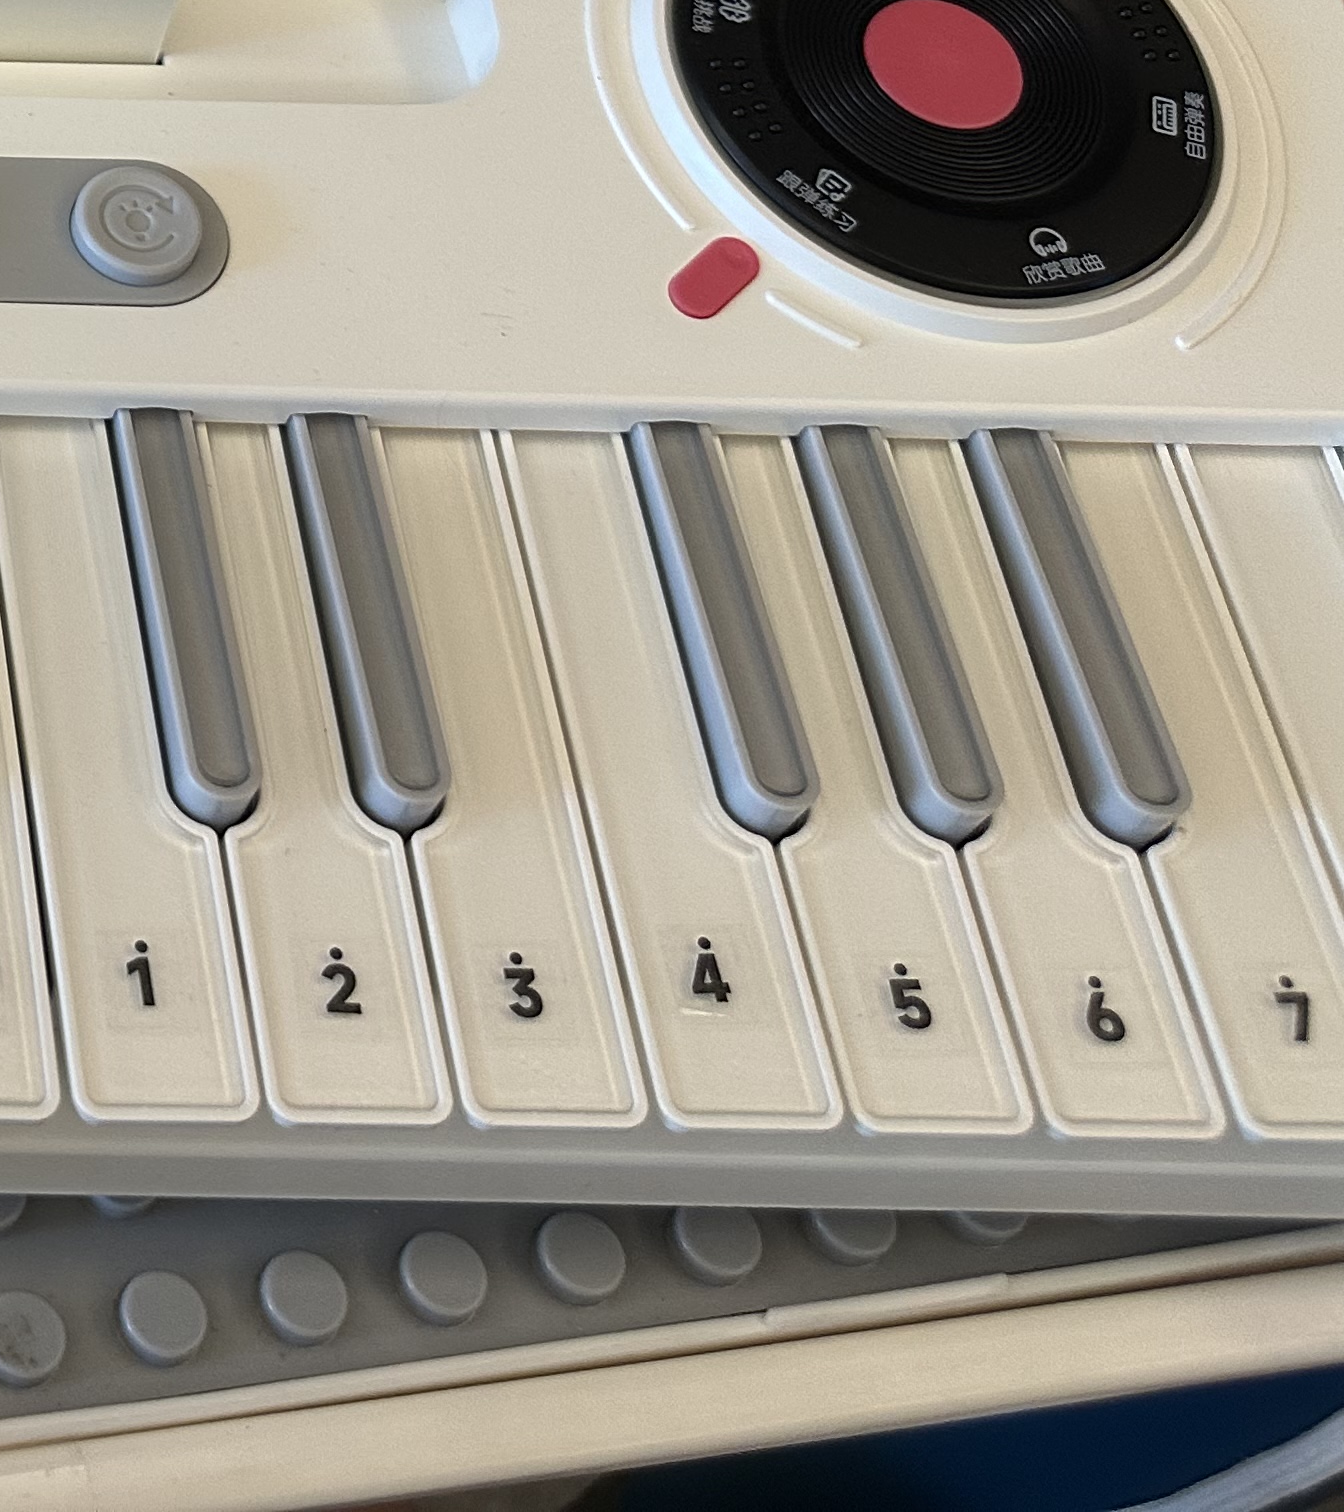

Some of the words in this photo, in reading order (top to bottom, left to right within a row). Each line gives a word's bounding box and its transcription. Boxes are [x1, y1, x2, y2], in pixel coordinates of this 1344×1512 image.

[1183, 90, 1206, 160] 自由弹奏
[776, 169, 859, 232] 跟弹练习
[1022, 252, 1105, 285] 欣赏歌曲
